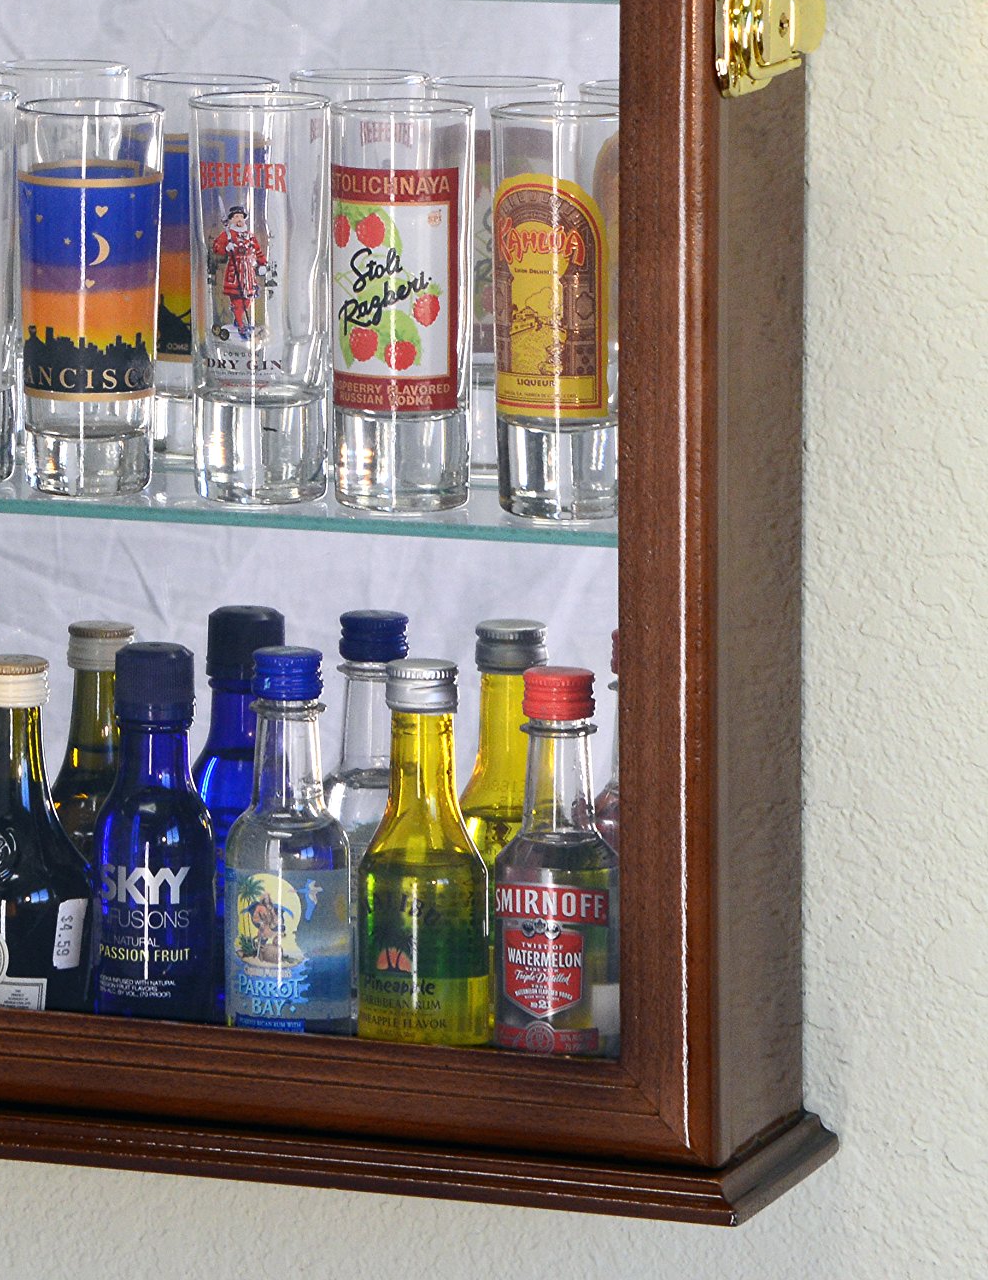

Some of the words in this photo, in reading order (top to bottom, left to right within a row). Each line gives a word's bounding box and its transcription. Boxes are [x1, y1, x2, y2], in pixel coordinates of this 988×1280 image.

[200, 162, 287, 193] BEEFEATER
[349, 247, 403, 293] Stoli
[206, 357, 239, 370] DRY
[246, 358, 283, 371] GIN
[387, 382, 451, 396] FLAVORED
[517, 378, 556, 387] LIQUEUR
[339, 391, 383, 406] RUSSIAN
[389, 394, 434, 407] VODKA
[99, 865, 192, 905] SKYY
[495, 887, 605, 919] SMIRNOFF
[57, 914, 72, 957] $4.59
[113, 934, 160, 948] NATURAL
[99, 943, 150, 962] PASSION
[154, 947, 191, 962] FRUIT
[521, 941, 548, 950] TWIST
[507, 946, 583, 968] WATERMELON
[238, 973, 302, 999] PARROT
[252, 997, 286, 1017] BAY
[415, 1000, 442, 1010] RUM
